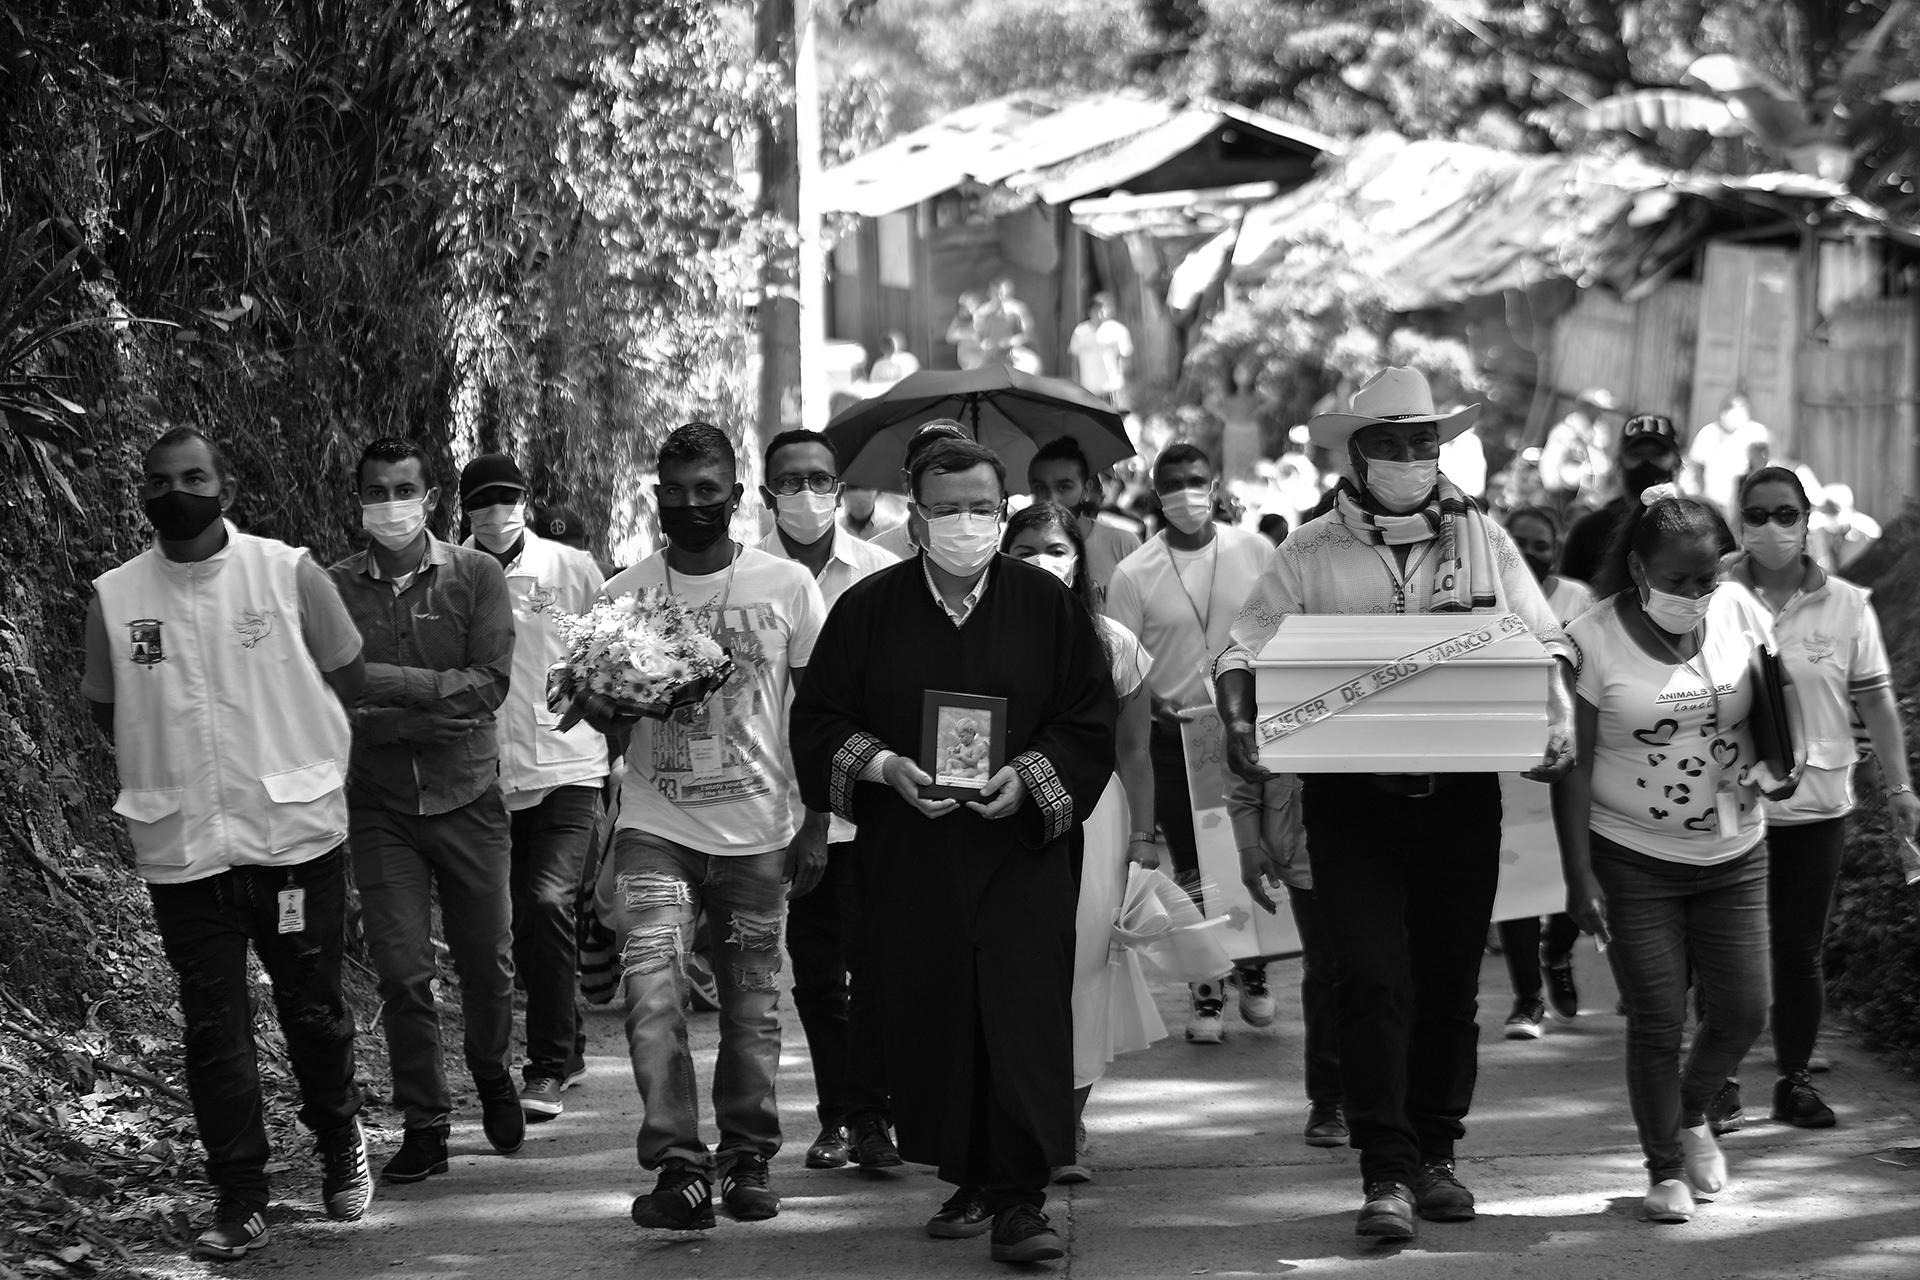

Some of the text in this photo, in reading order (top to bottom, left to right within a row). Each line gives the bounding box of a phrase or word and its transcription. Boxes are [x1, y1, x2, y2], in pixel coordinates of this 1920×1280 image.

[1340, 681, 1366, 703] DE
[1371, 657, 1419, 690] JESUS
[1658, 688, 1708, 701] ANIMALS
